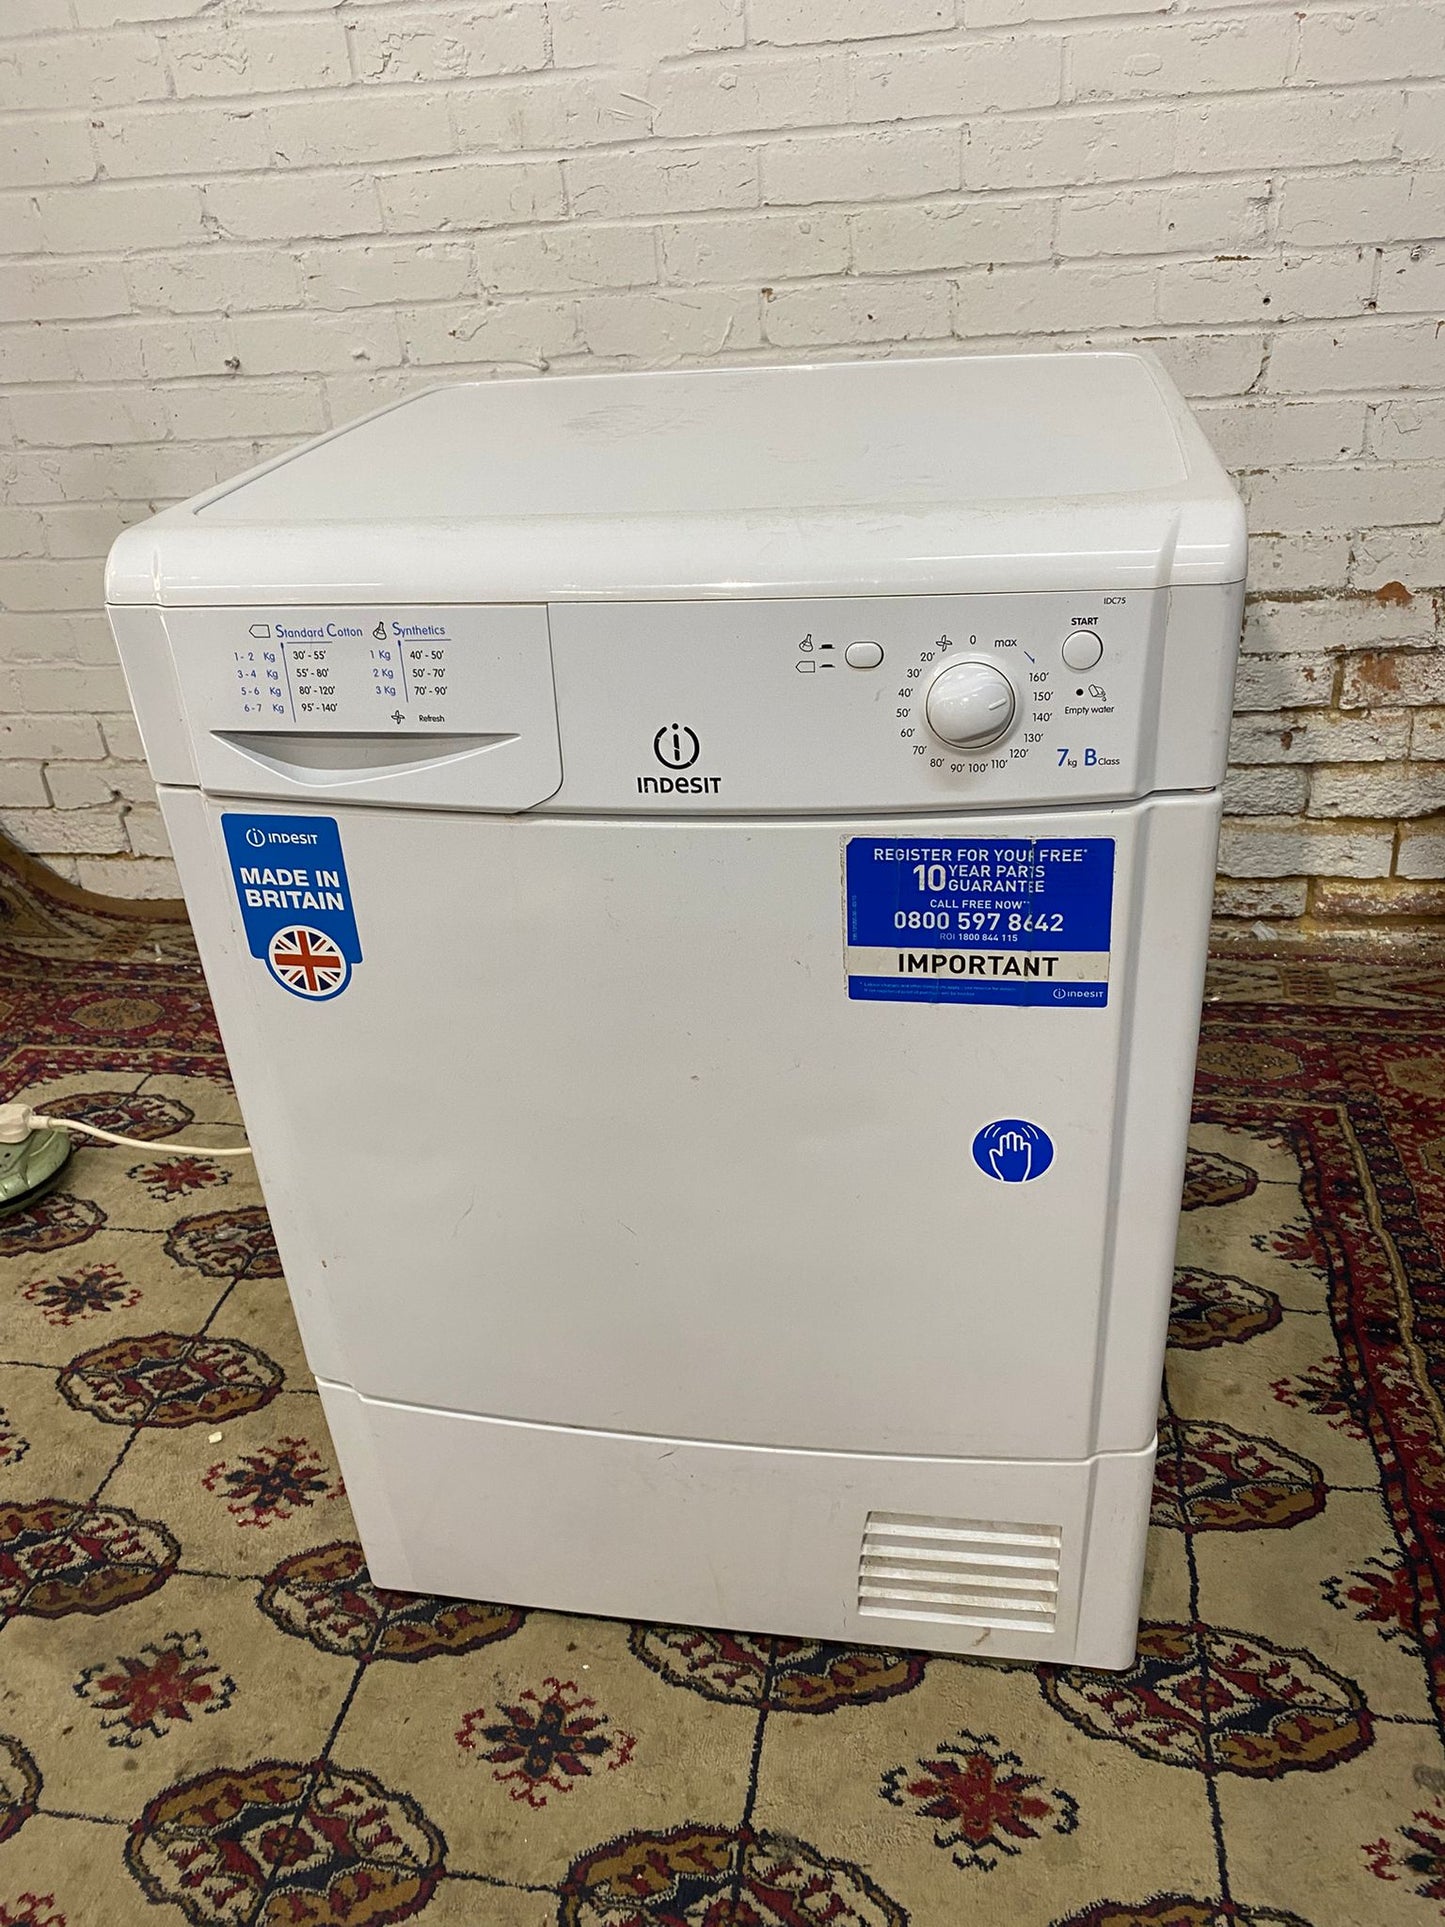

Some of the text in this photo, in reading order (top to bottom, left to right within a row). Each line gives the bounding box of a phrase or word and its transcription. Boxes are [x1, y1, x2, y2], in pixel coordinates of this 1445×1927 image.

[1103, 597, 1126, 605] IDC75
[1071, 617, 1099, 626] START
[275, 623, 363, 638] Standard Cotton
[392, 622, 446, 638] Synthetics
[994, 638, 1017, 648] max
[264, 652, 276, 663] Kg
[370, 650, 391, 661] 1 Kg
[267, 670, 279, 680] Kg
[373, 669, 394, 679] 2 Kg
[270, 687, 282, 697] Kg
[376, 686, 396, 697] 3 Kg
[273, 704, 284, 714] Kg
[1065, 705, 1115, 716] Empty water
[419, 714, 445, 723] Refresh
[874, 848, 952, 862] REGISTER
[957, 849, 989, 862] FOR
[240, 867, 340, 888] MADE IN
[949, 865, 1046, 879] YEAR PARTS
[913, 864, 947, 892] 10
[948, 879, 1045, 893] GUARANTEE
[244, 889, 345, 911] BRITAIN
[930, 899, 959, 909] CALL
[962, 899, 992, 910] FREE
[894, 911, 1064, 933] 0800 597 8642
[959, 933, 980, 941] 1800
[982, 933, 999, 942] 844
[1001, 934, 1018, 942] 115
[898, 953, 1059, 977] IMPORTANT
